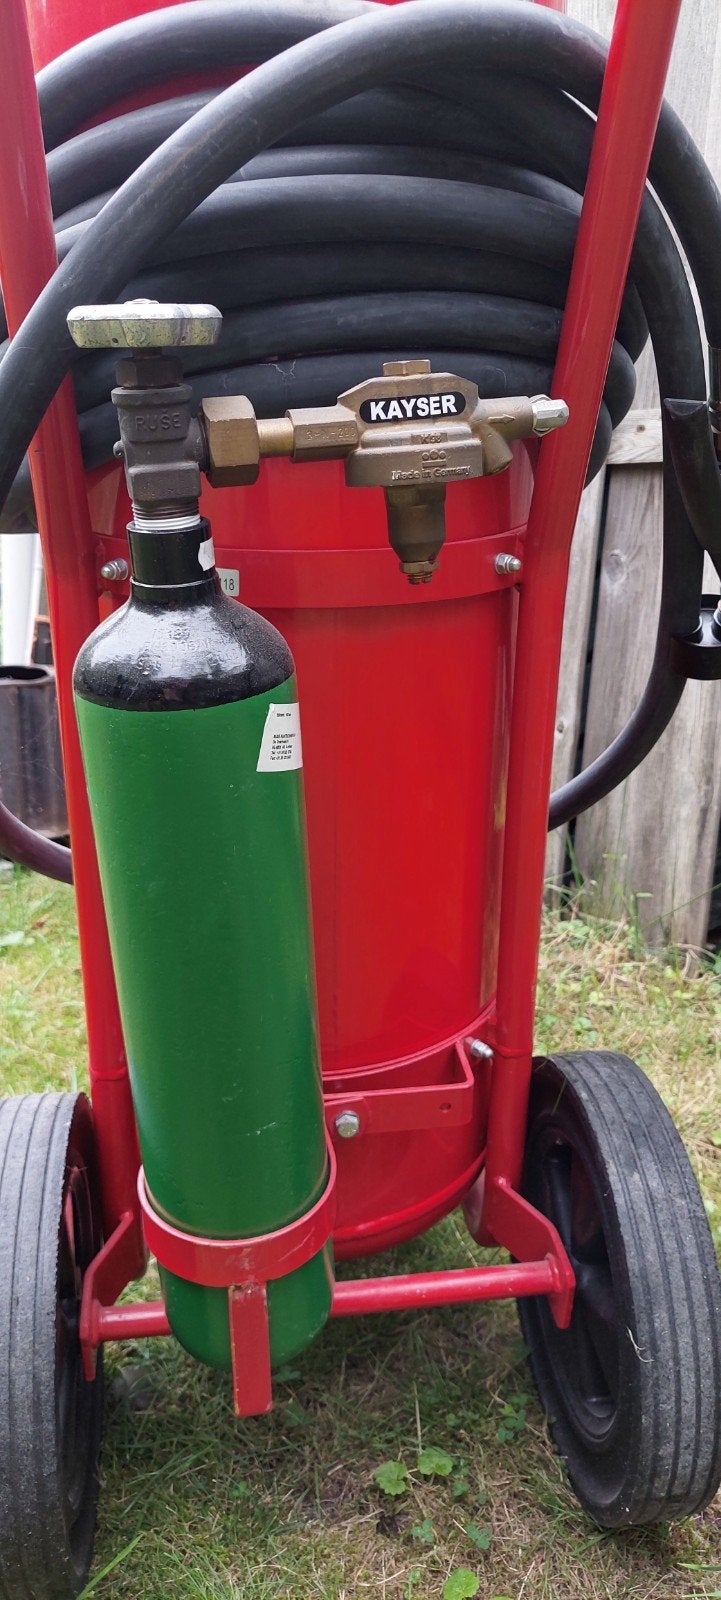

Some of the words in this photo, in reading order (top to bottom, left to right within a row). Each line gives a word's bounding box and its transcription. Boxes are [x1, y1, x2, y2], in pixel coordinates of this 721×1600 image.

[369, 394, 457, 421] KAYSER
[391, 469, 419, 481] Made
[422, 469, 431, 479] in
[433, 465, 471, 477] Germany
